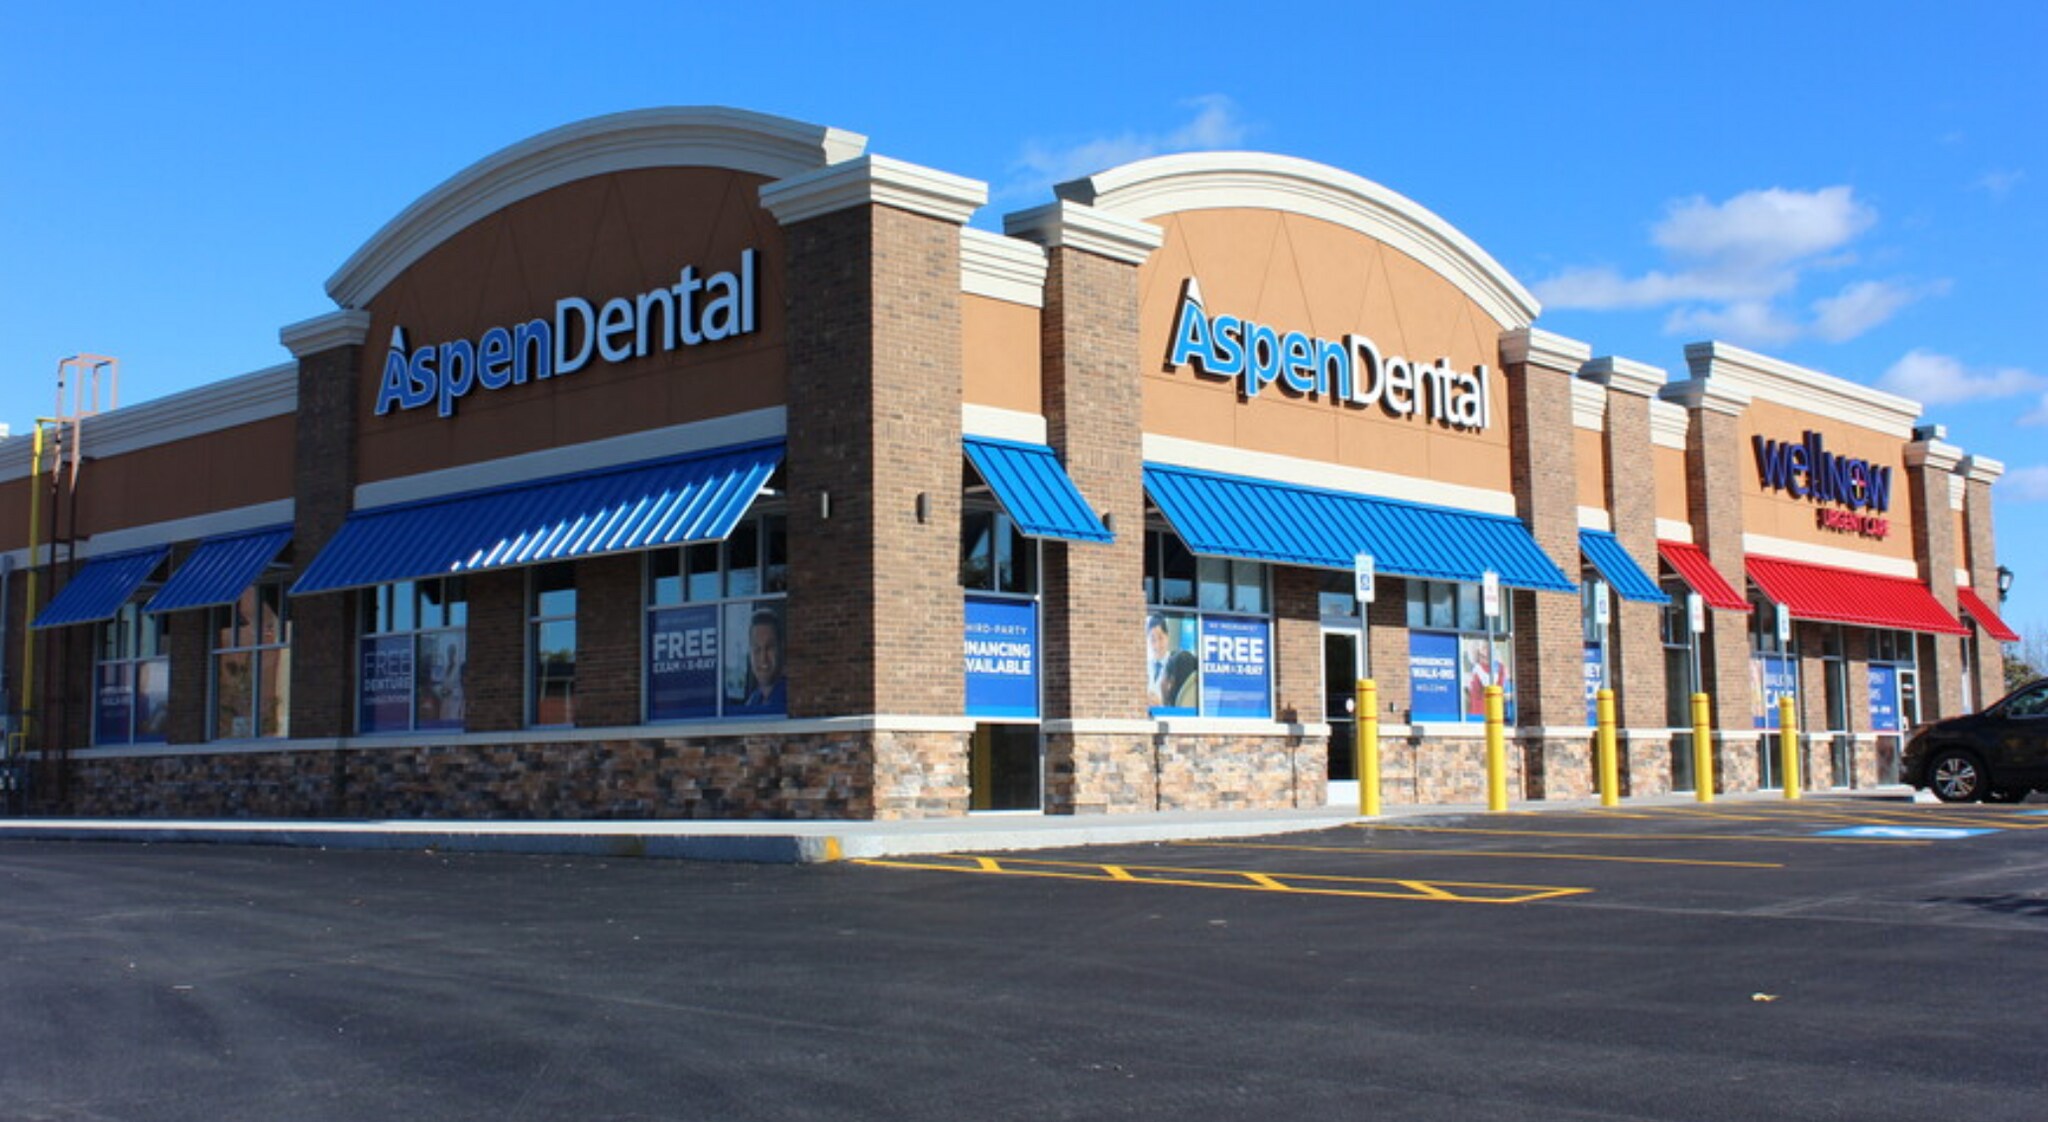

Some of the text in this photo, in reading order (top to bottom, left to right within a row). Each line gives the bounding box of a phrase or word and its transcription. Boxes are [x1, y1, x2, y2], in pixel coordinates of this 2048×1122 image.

[374, 247, 758, 418] AspenDental
[1170, 275, 1491, 430] AspenDental
[653, 627, 717, 660] FREE
[964, 641, 1031, 658] INANCING
[1204, 634, 1265, 663] FREE
[364, 649, 412, 679] FREE
[965, 657, 1031, 675] VAILABLE
